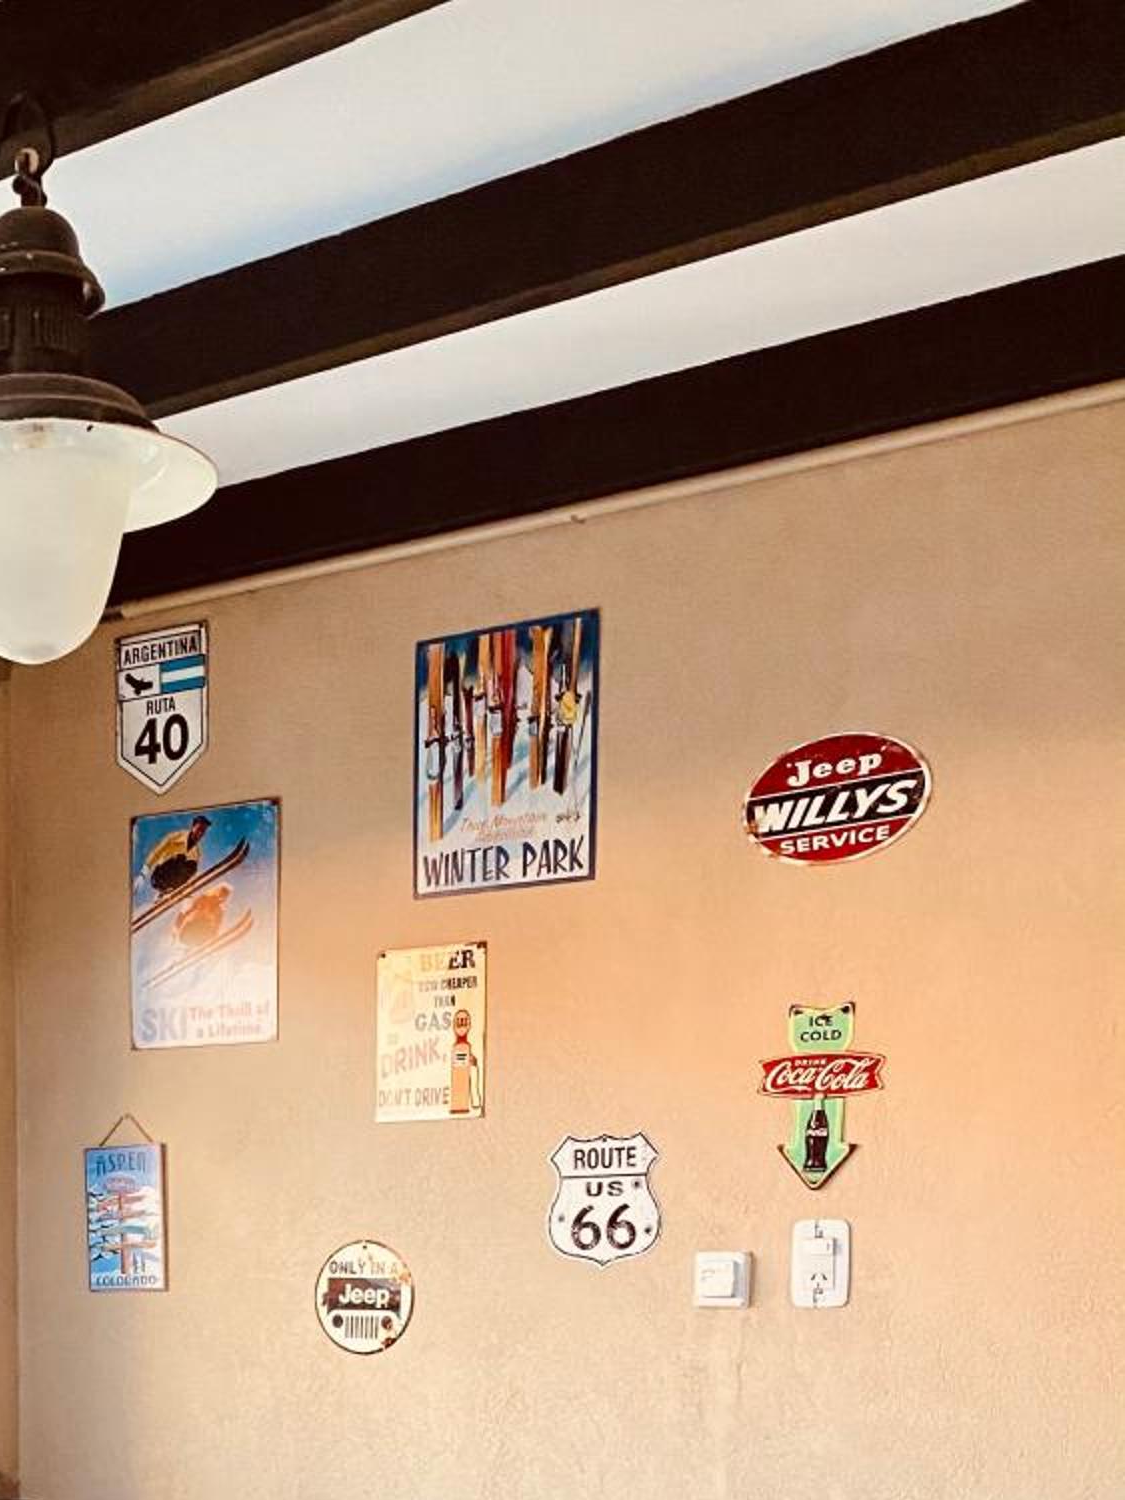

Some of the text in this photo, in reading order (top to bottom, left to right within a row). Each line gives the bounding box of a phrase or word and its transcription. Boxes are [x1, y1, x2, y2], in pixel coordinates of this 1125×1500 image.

[123, 635, 199, 666] ARGENTINA
[146, 696, 176, 715] RUTA
[134, 713, 190, 765] 40
[754, 779, 917, 833] WILLYS
[779, 825, 890, 855] SERVICE
[422, 834, 585, 888] WINTER PARK
[419, 949, 477, 973] BEER
[139, 1007, 187, 1042] SKI
[414, 1011, 452, 1033] GAS
[808, 1014, 834, 1027] ICE
[800, 1029, 842, 1043] COLD
[766, 1058, 873, 1093] Coca-Cola
[415, 1087, 450, 1107] DRIVE
[96, 1151, 147, 1178] ASPEN
[573, 1145, 637, 1170] ROUTE
[586, 1180, 623, 1197] US
[571, 1203, 637, 1251] 66
[328, 1257, 367, 1275] ONLY
[96, 1274, 157, 1287] COLORADO
[338, 1283, 390, 1309] Jeep
